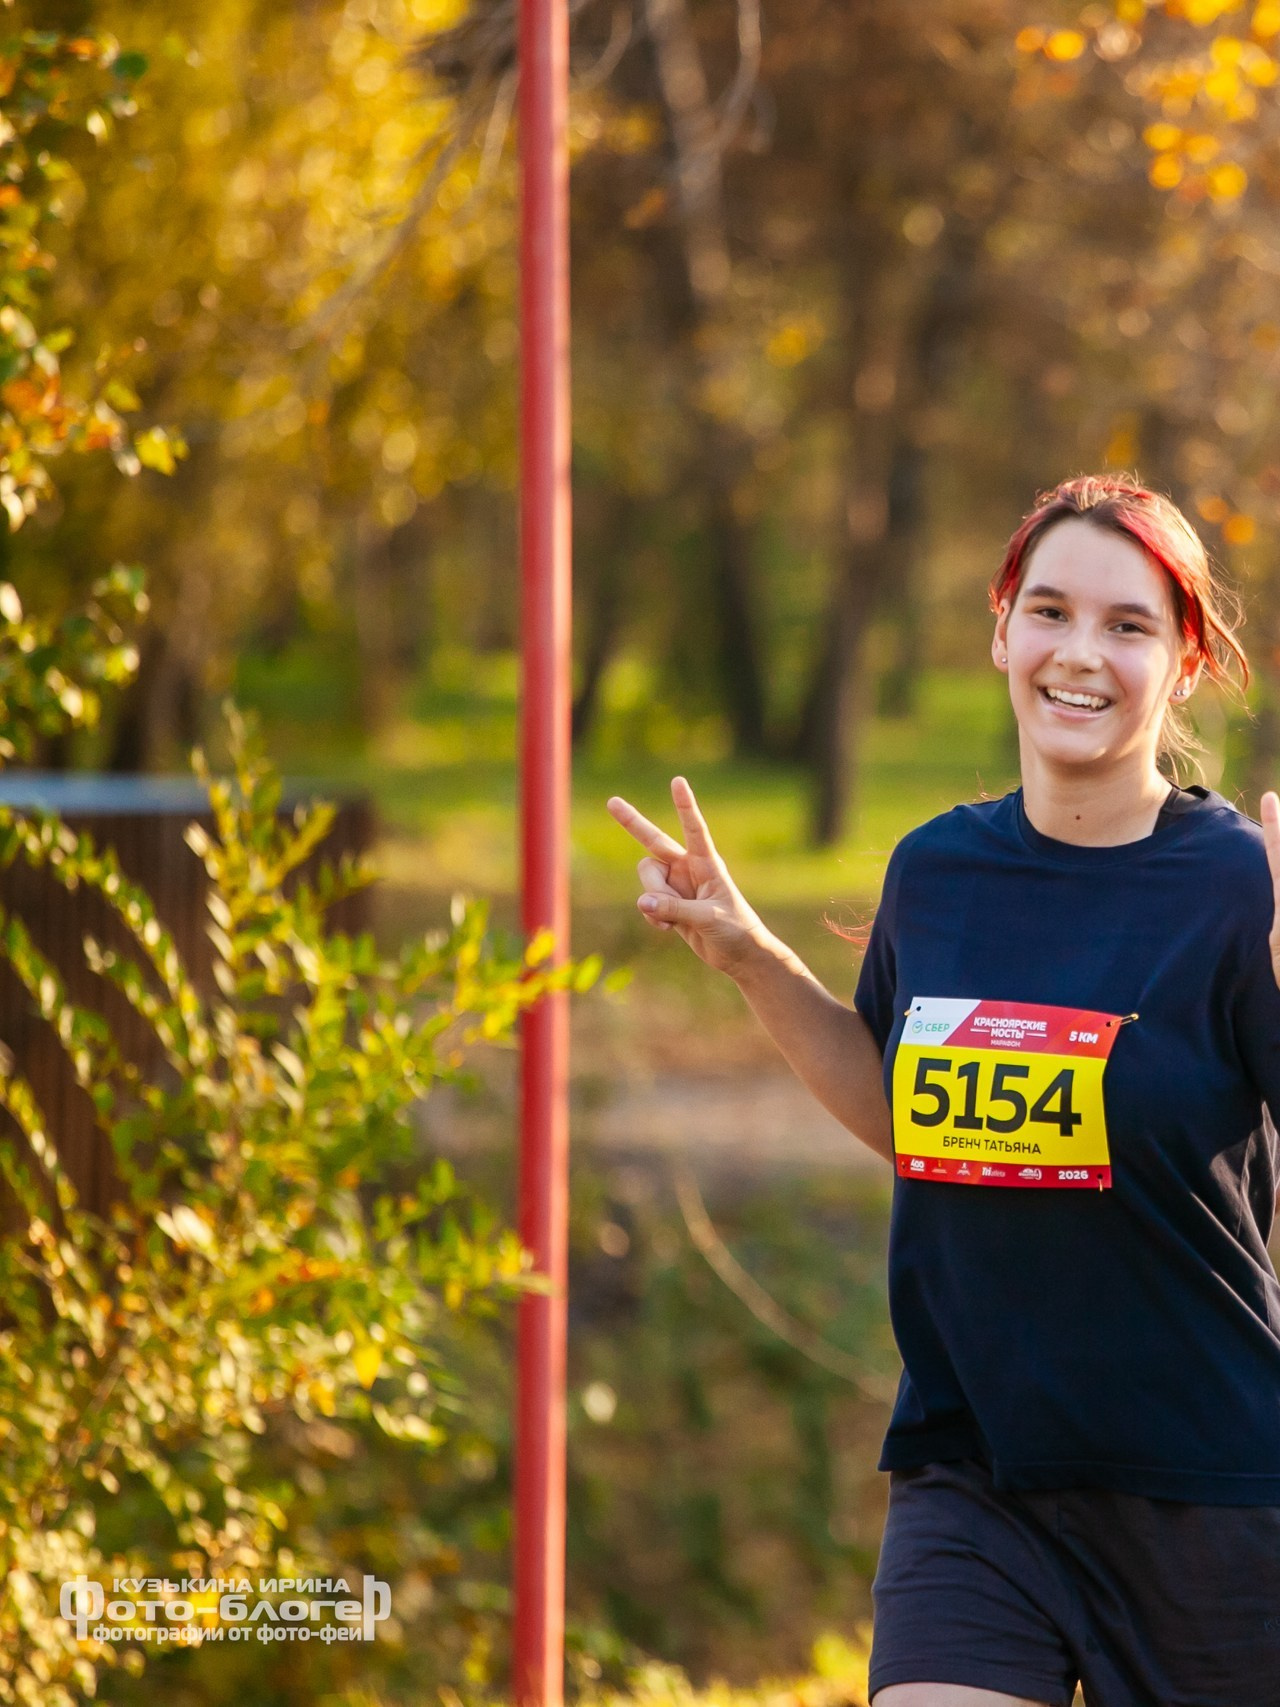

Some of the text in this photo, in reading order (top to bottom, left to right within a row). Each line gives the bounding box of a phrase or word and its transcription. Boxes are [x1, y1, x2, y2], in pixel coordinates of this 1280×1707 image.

[925, 1023, 950, 1033] СБЕР
[973, 1017, 1047, 1032] КРАСНОЯРСКИЕ
[990, 1028, 1025, 1039] МОСТЫ
[1069, 1031, 1078, 1042] 5
[910, 1057, 1082, 1137] 5154
[943, 1136, 1042, 1155] БРЕНЧ ТАТЬЯНА
[1058, 1170, 1089, 1180] 2026
